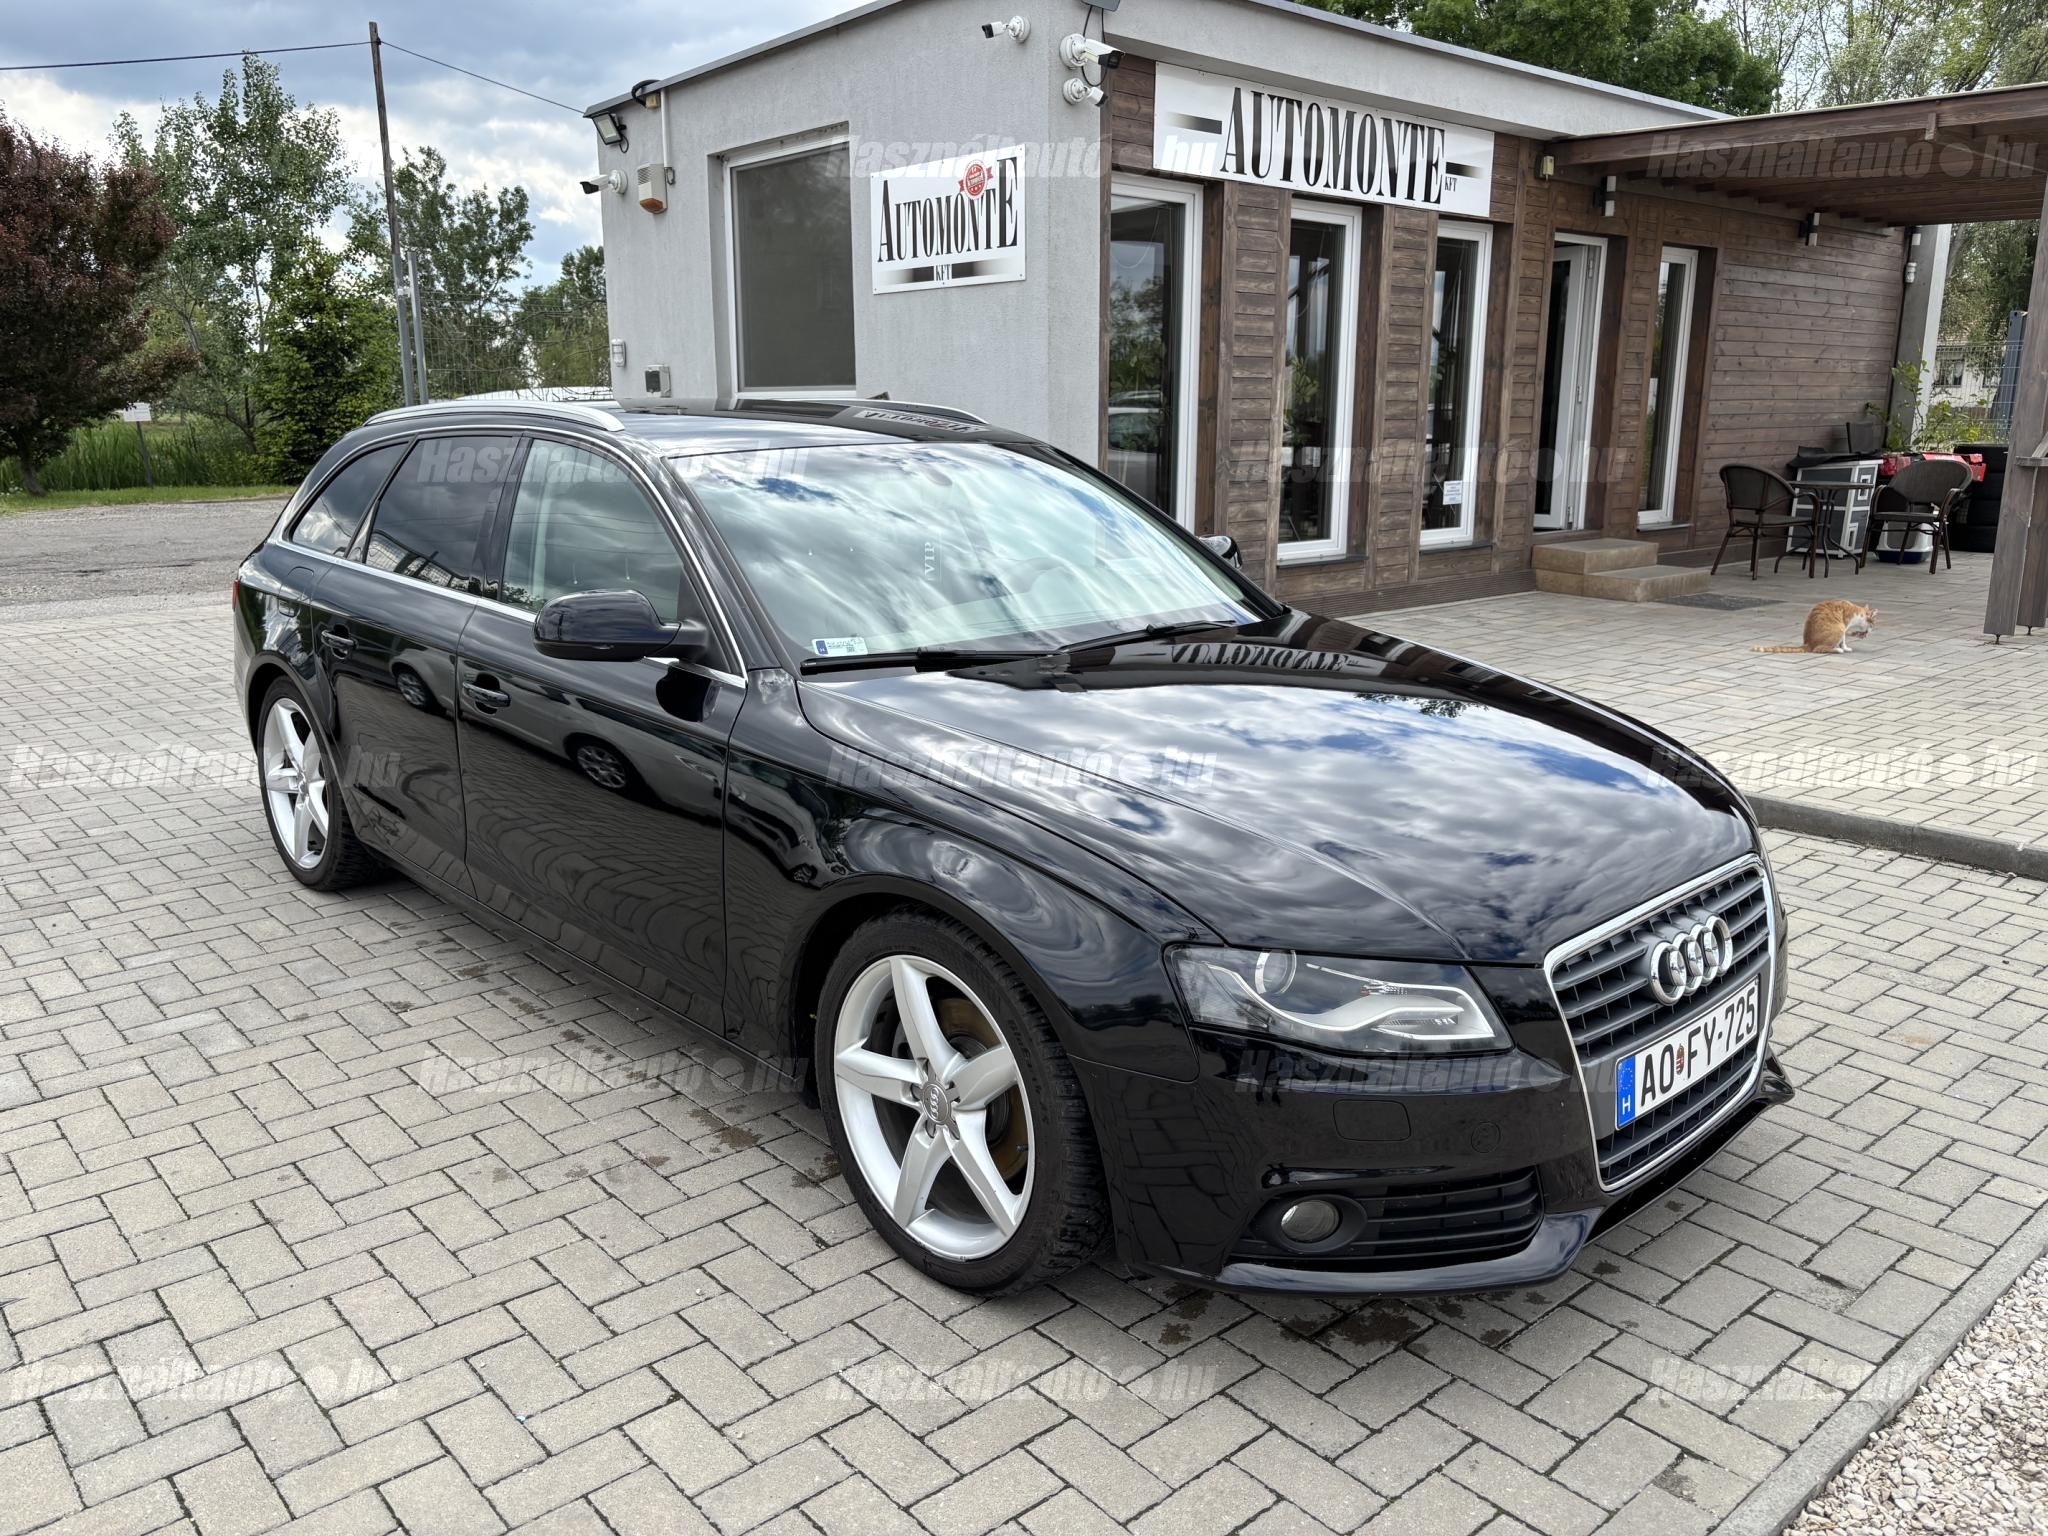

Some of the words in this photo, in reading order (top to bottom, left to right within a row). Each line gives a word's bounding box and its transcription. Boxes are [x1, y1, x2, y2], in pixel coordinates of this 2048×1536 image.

[1219, 87, 1445, 205] AUTOMONTE
[1444, 177, 1458, 193] KFT
[877, 156, 1018, 263] AUTOMONTE
[935, 263, 951, 282] KFT
[1621, 1094, 1632, 1116] H
